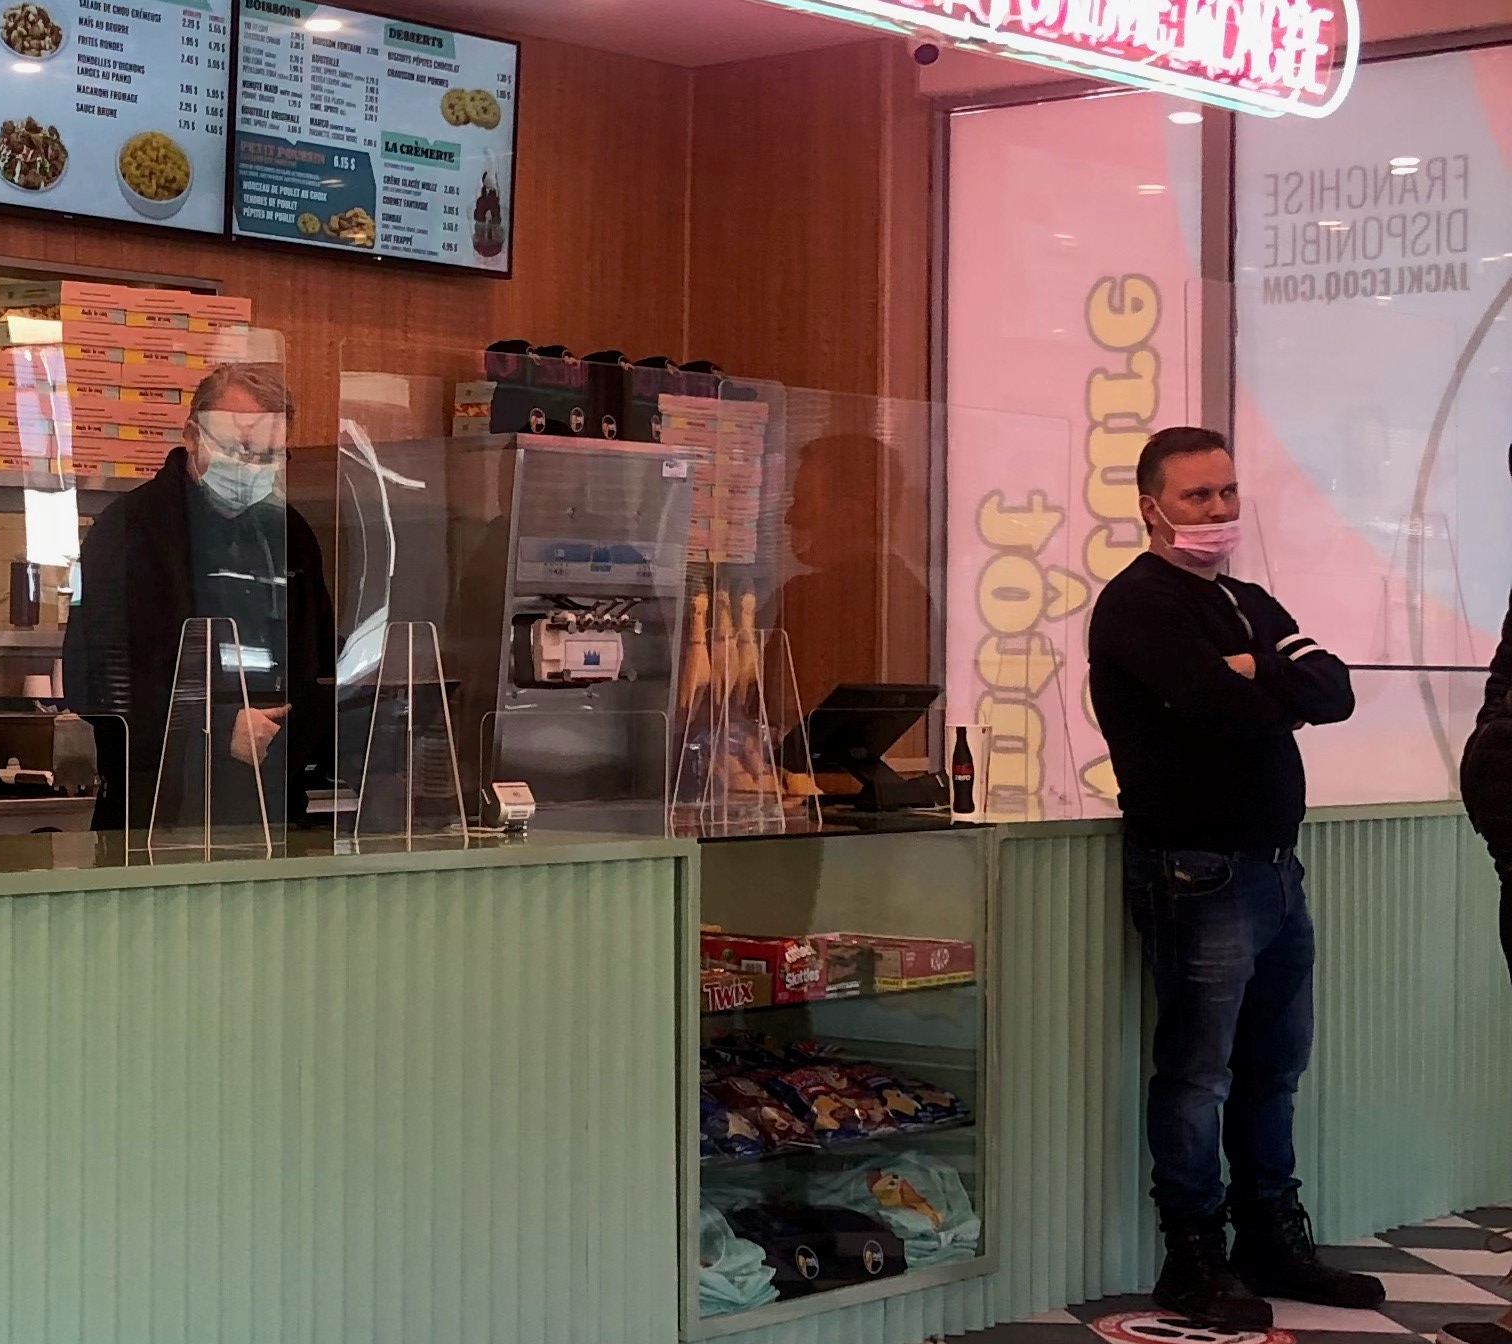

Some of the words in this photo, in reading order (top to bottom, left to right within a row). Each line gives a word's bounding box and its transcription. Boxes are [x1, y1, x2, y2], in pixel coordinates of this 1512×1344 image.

[388, 26, 443, 49] DESSERTS
[384, 140, 397, 154] LA
[399, 140, 455, 164] CRÈMERIE
